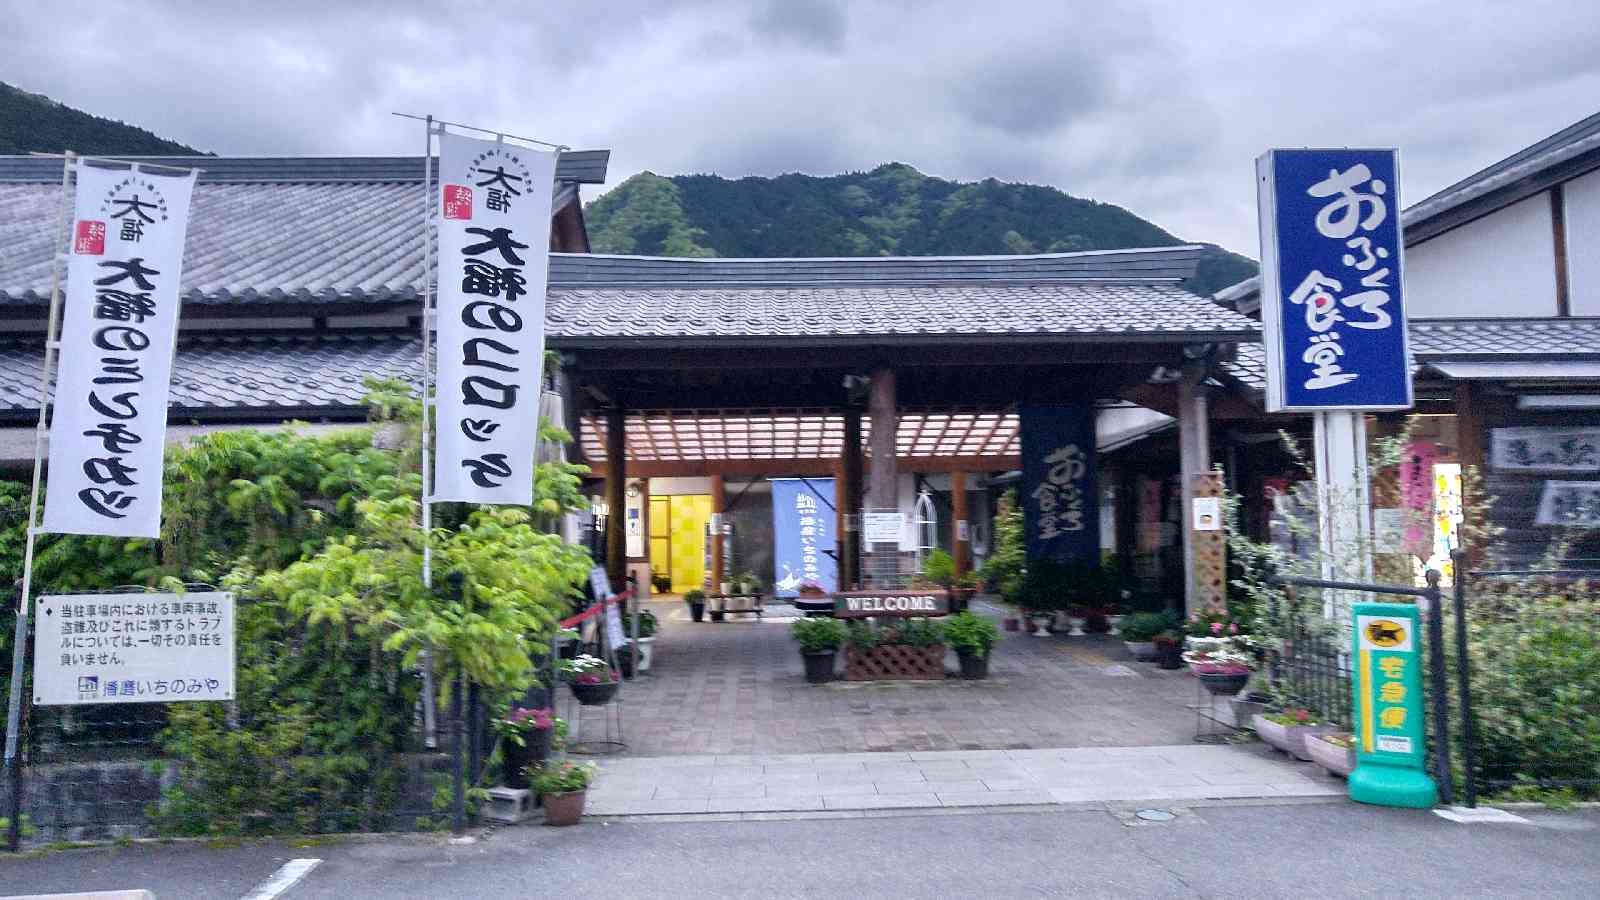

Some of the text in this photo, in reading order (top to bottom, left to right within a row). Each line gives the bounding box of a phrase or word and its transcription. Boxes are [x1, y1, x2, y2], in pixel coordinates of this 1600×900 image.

[1306, 163, 1392, 330] おふくろ
[1288, 269, 1362, 390] 食堂
[846, 597, 937, 611] WELCOME
[60, 633, 223, 649] ルについては、一切その責任を
[60, 651, 126, 666] 負いません。
[103, 678, 220, 697] 播磨いちのみや
